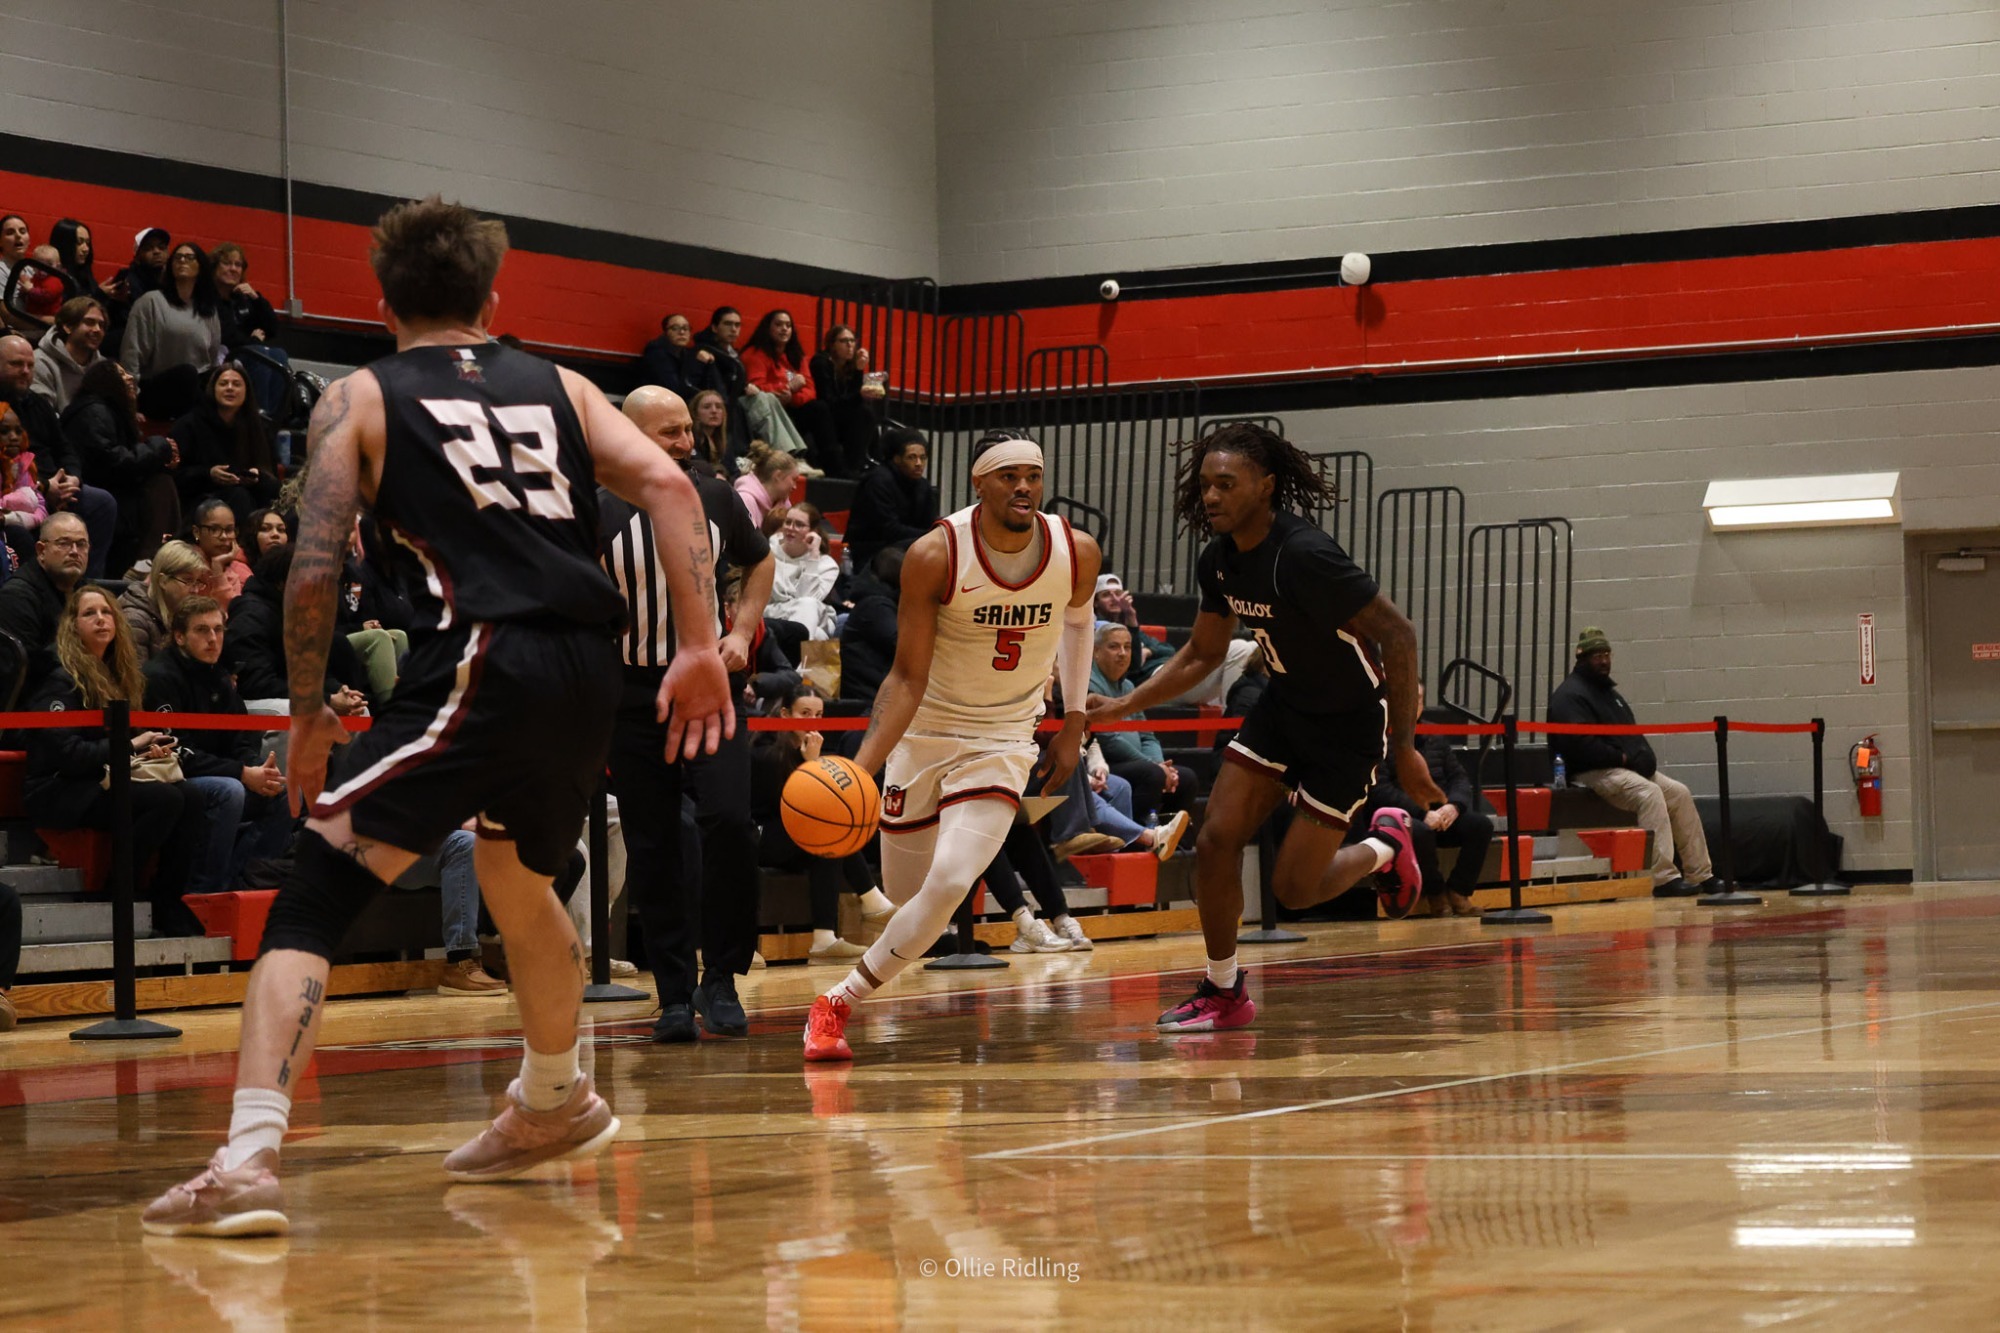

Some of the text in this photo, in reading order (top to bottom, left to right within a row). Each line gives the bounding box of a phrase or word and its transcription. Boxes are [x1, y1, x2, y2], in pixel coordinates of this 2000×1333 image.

[417, 398, 576, 520] 23
[1860, 618, 1872, 626] FIRE
[992, 629, 1026, 672] 5
[1973, 643, 2000, 651] EMERGEN
